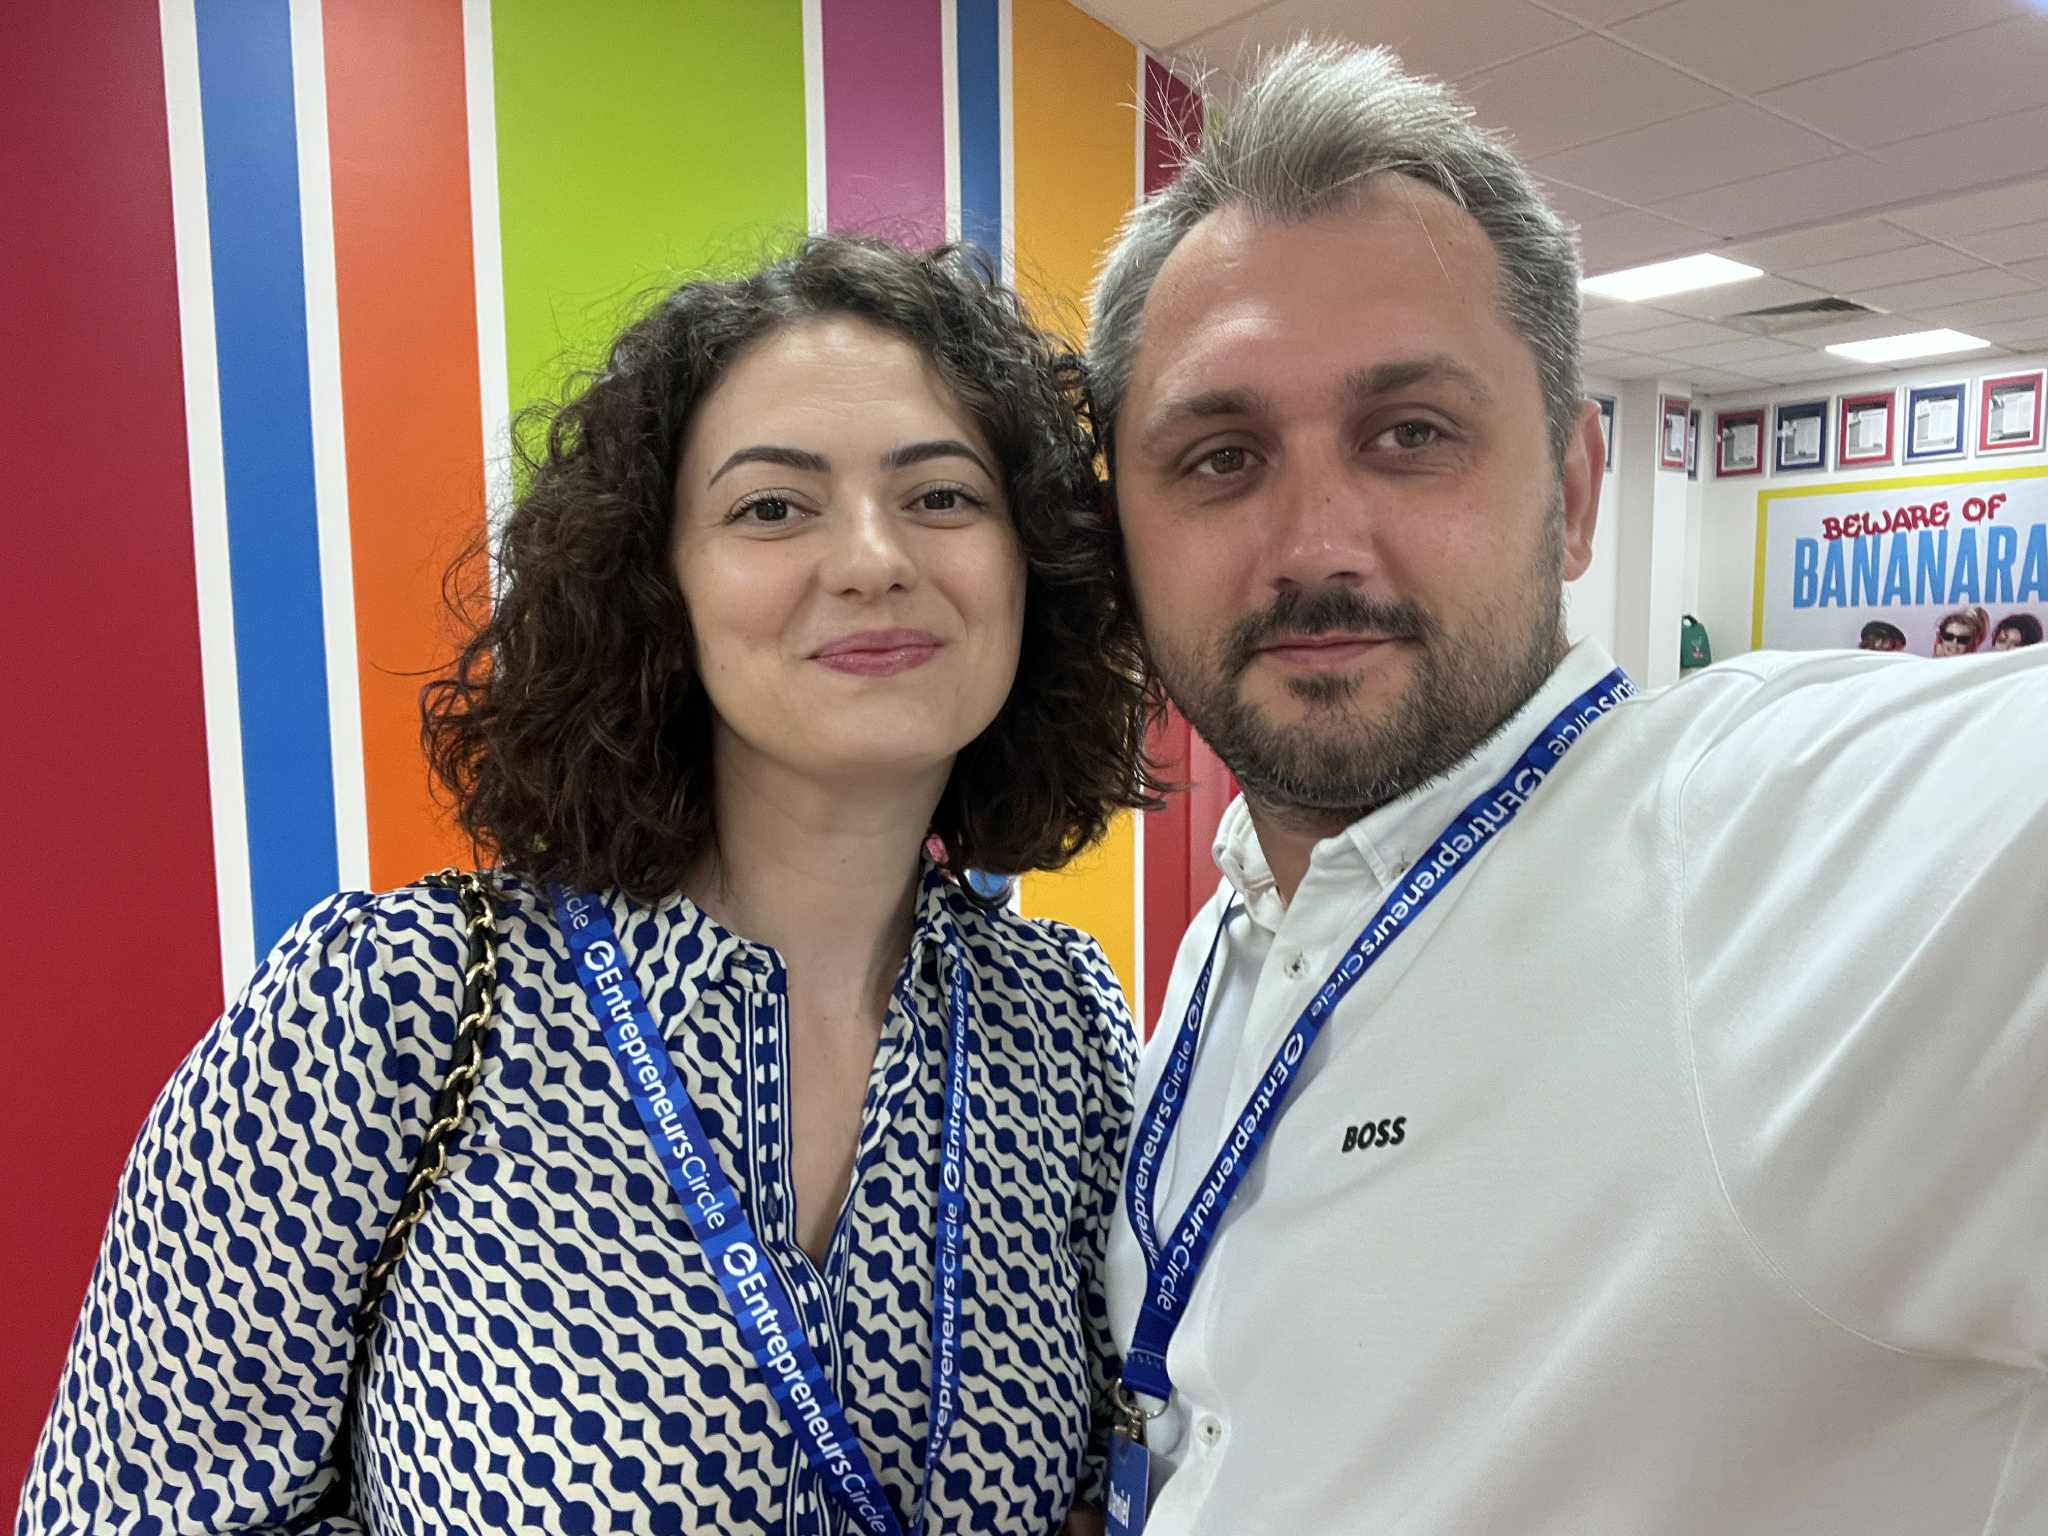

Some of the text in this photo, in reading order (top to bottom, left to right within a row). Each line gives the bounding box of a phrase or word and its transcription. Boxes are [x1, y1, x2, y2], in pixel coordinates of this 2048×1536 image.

[1793, 523, 2048, 609] BANANARA
[1823, 493, 2007, 541] BEWARE OF
[595, 966, 726, 1230] EntrepreneursCircle
[1342, 1116, 1407, 1153] BOSS
[1157, 1063, 1289, 1312] EntrepreneursCircle
[736, 1276, 887, 1534] EntrepreneursCircle
